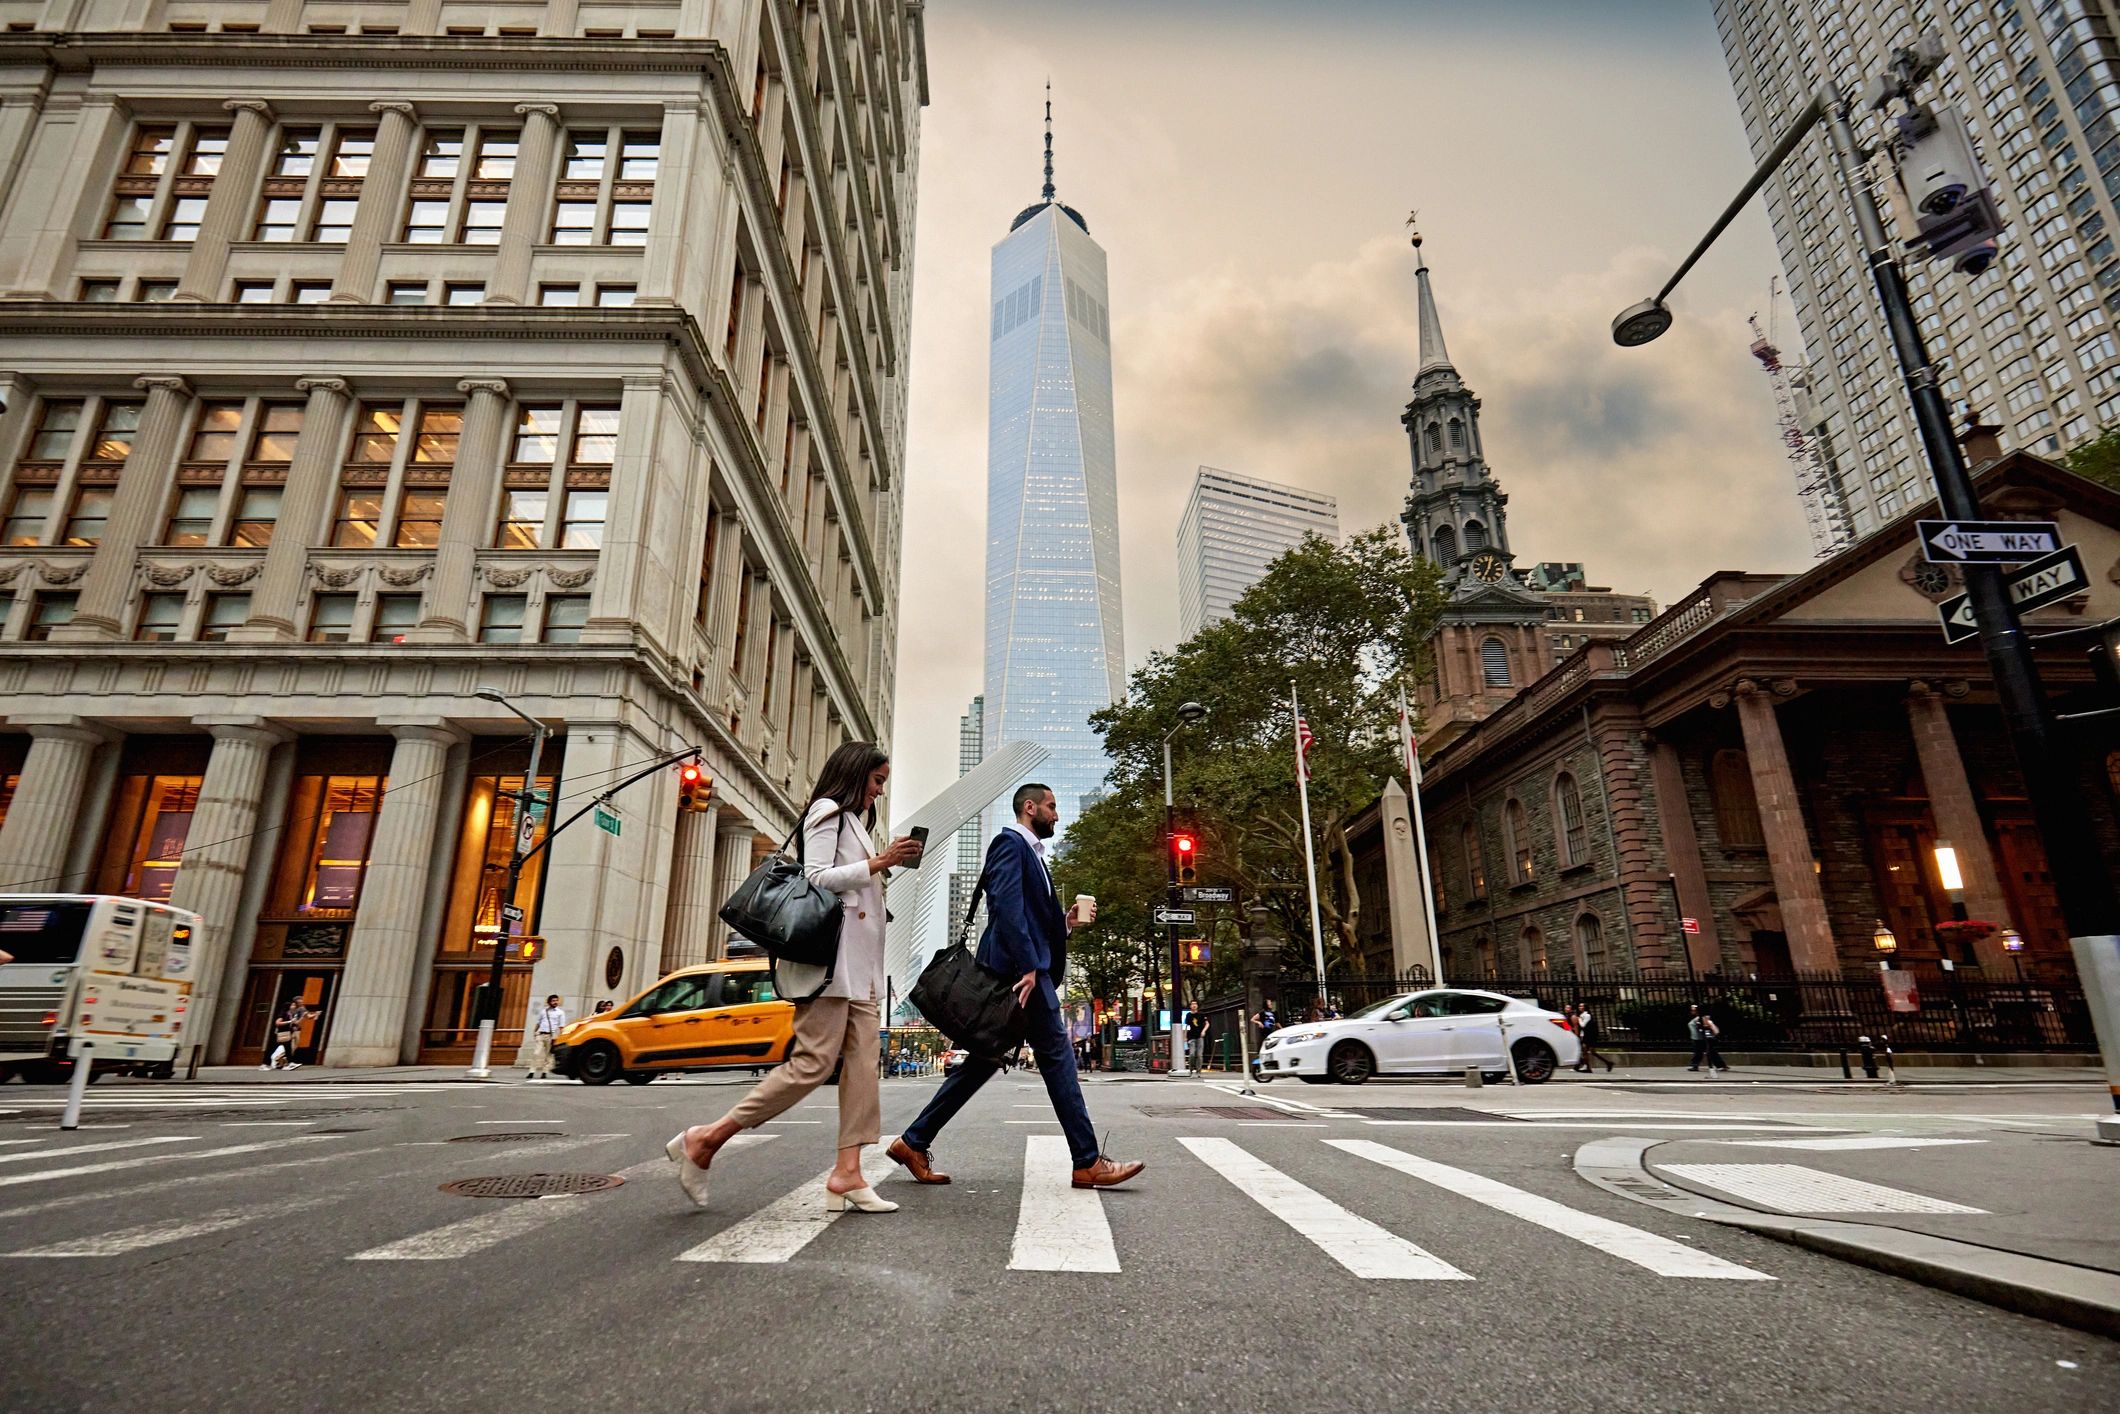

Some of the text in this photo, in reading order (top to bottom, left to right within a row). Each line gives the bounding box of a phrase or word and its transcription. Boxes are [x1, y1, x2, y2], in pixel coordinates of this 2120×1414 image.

[1944, 533, 2043, 551] ONE WAY
[2016, 567, 2062, 599] WAY
[1198, 891, 1229, 900] Broadway
